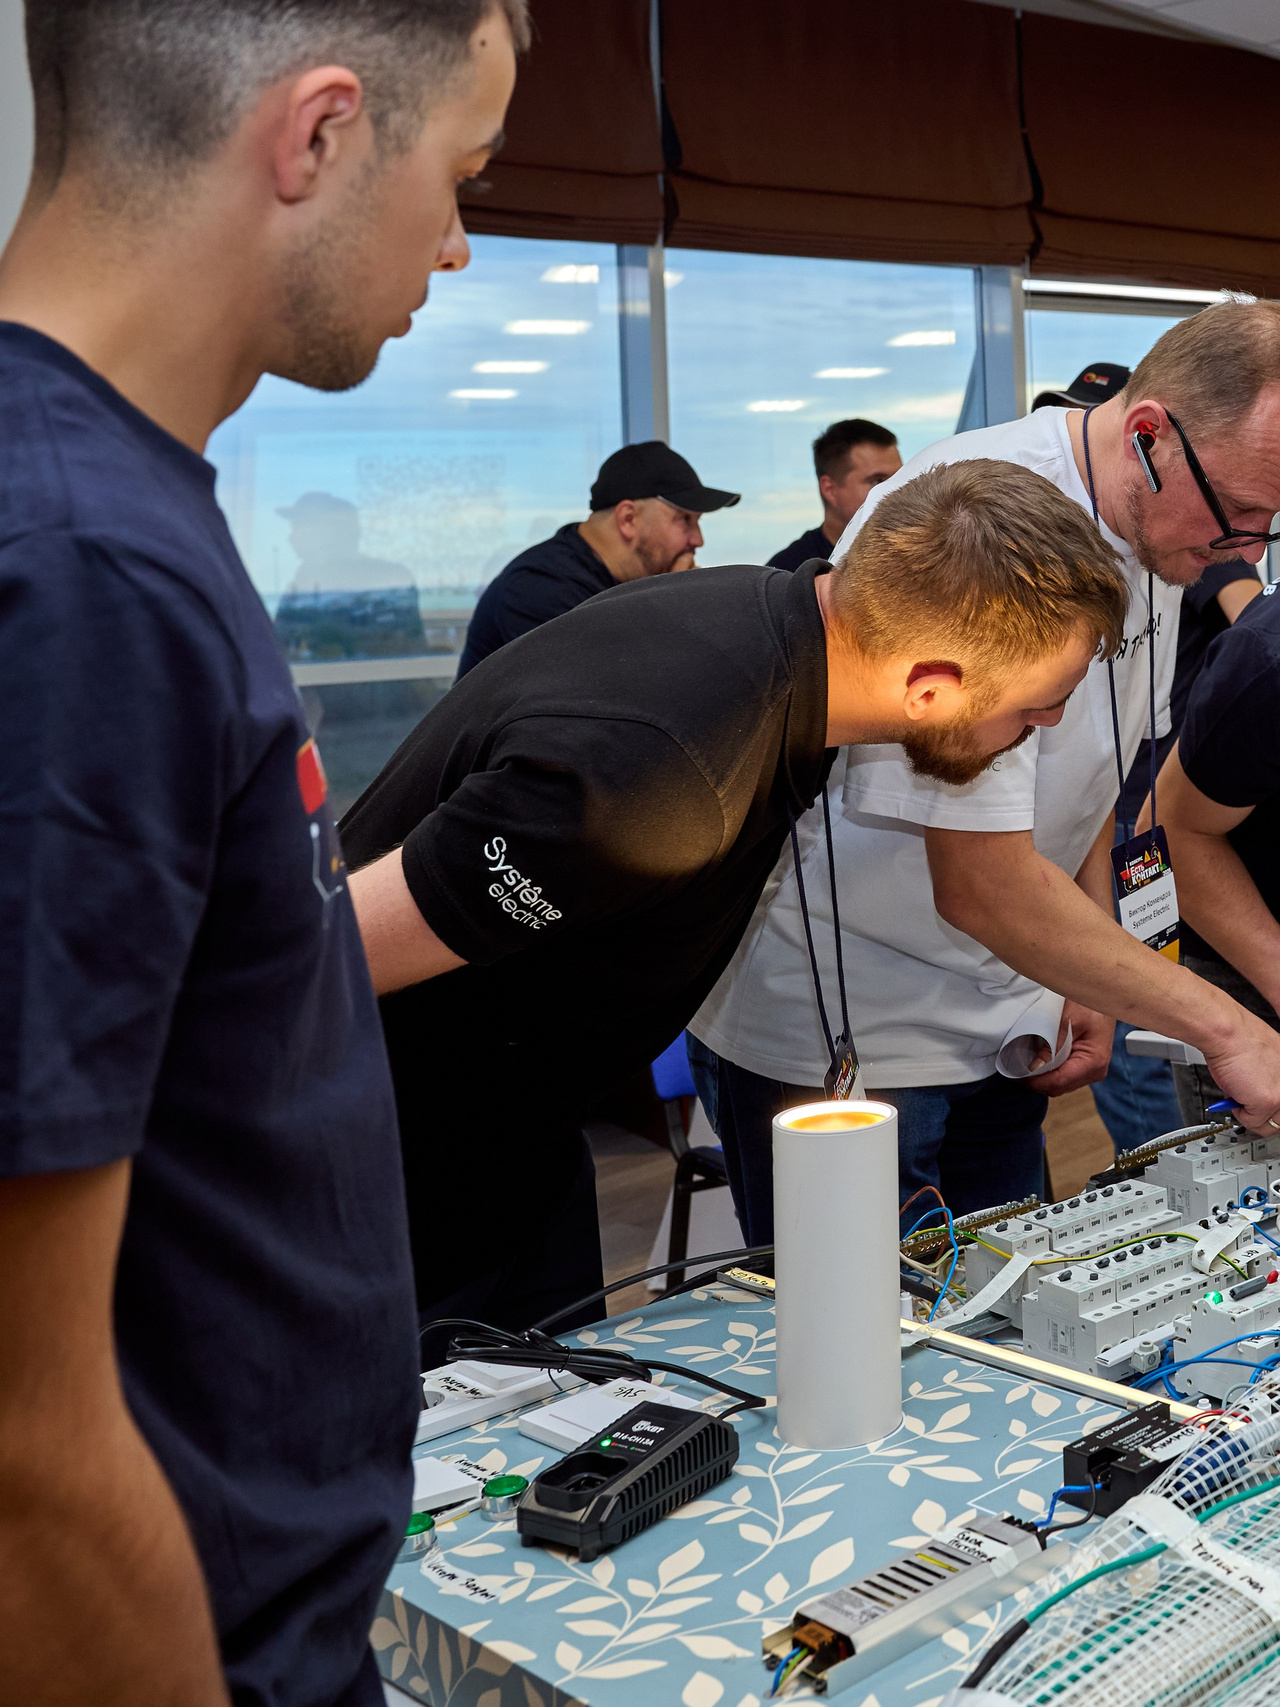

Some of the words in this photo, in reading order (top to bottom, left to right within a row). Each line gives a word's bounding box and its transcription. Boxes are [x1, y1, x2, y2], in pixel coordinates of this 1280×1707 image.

[1132, 862, 1160, 886] КОНТАКТ
[488, 883, 547, 930] electric
[1153, 903, 1171, 919] Electric
[1096, 1428, 1114, 1440] LED
[1111, 1416, 1139, 1433] Dimmer
